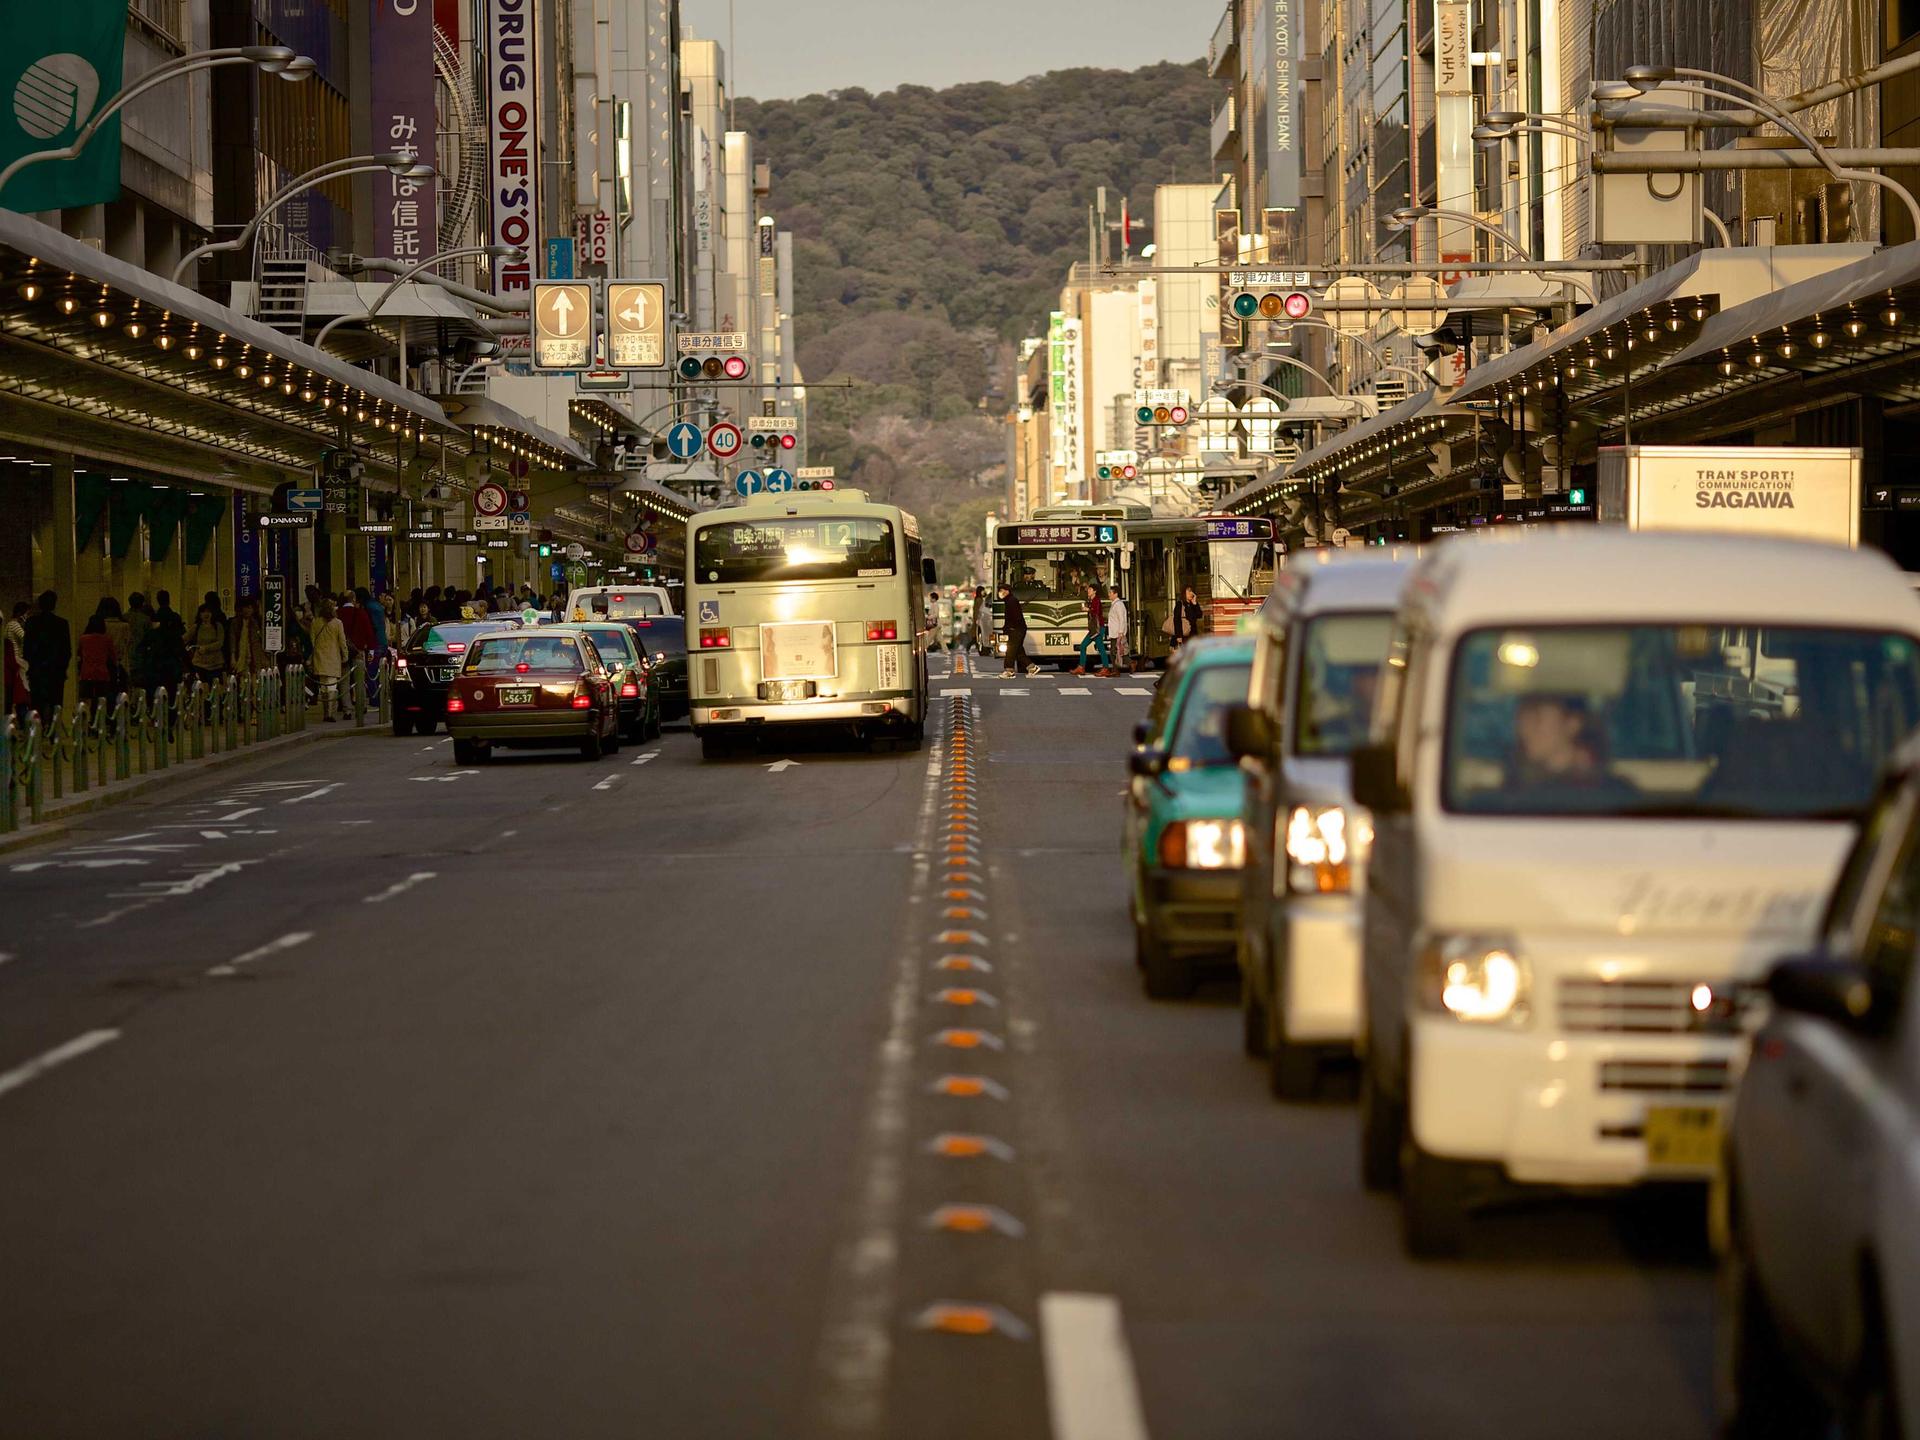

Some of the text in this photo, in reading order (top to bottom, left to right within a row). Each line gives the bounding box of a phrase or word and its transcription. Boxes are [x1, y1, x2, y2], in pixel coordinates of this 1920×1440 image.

[1275, 15, 1289, 56] KYOTO
[1276, 60, 1290, 110] SHINKIN
[1277, 110, 1291, 151] BANK
[681, 336, 743, 347] 歩車分離信号
[1067, 344, 1078, 471] TAKASHIMAYA
[716, 433, 734, 447] 40
[1697, 481, 1793, 489] COMMUNICATION
[1696, 491, 1795, 508] SAGAWA
[733, 527, 785, 544] 四条河原町
[1038, 527, 1071, 538] 京都駅
[1076, 528, 1091, 540] 5
[265, 581, 281, 590] TAXI
[509, 694, 532, 703] 56-37
